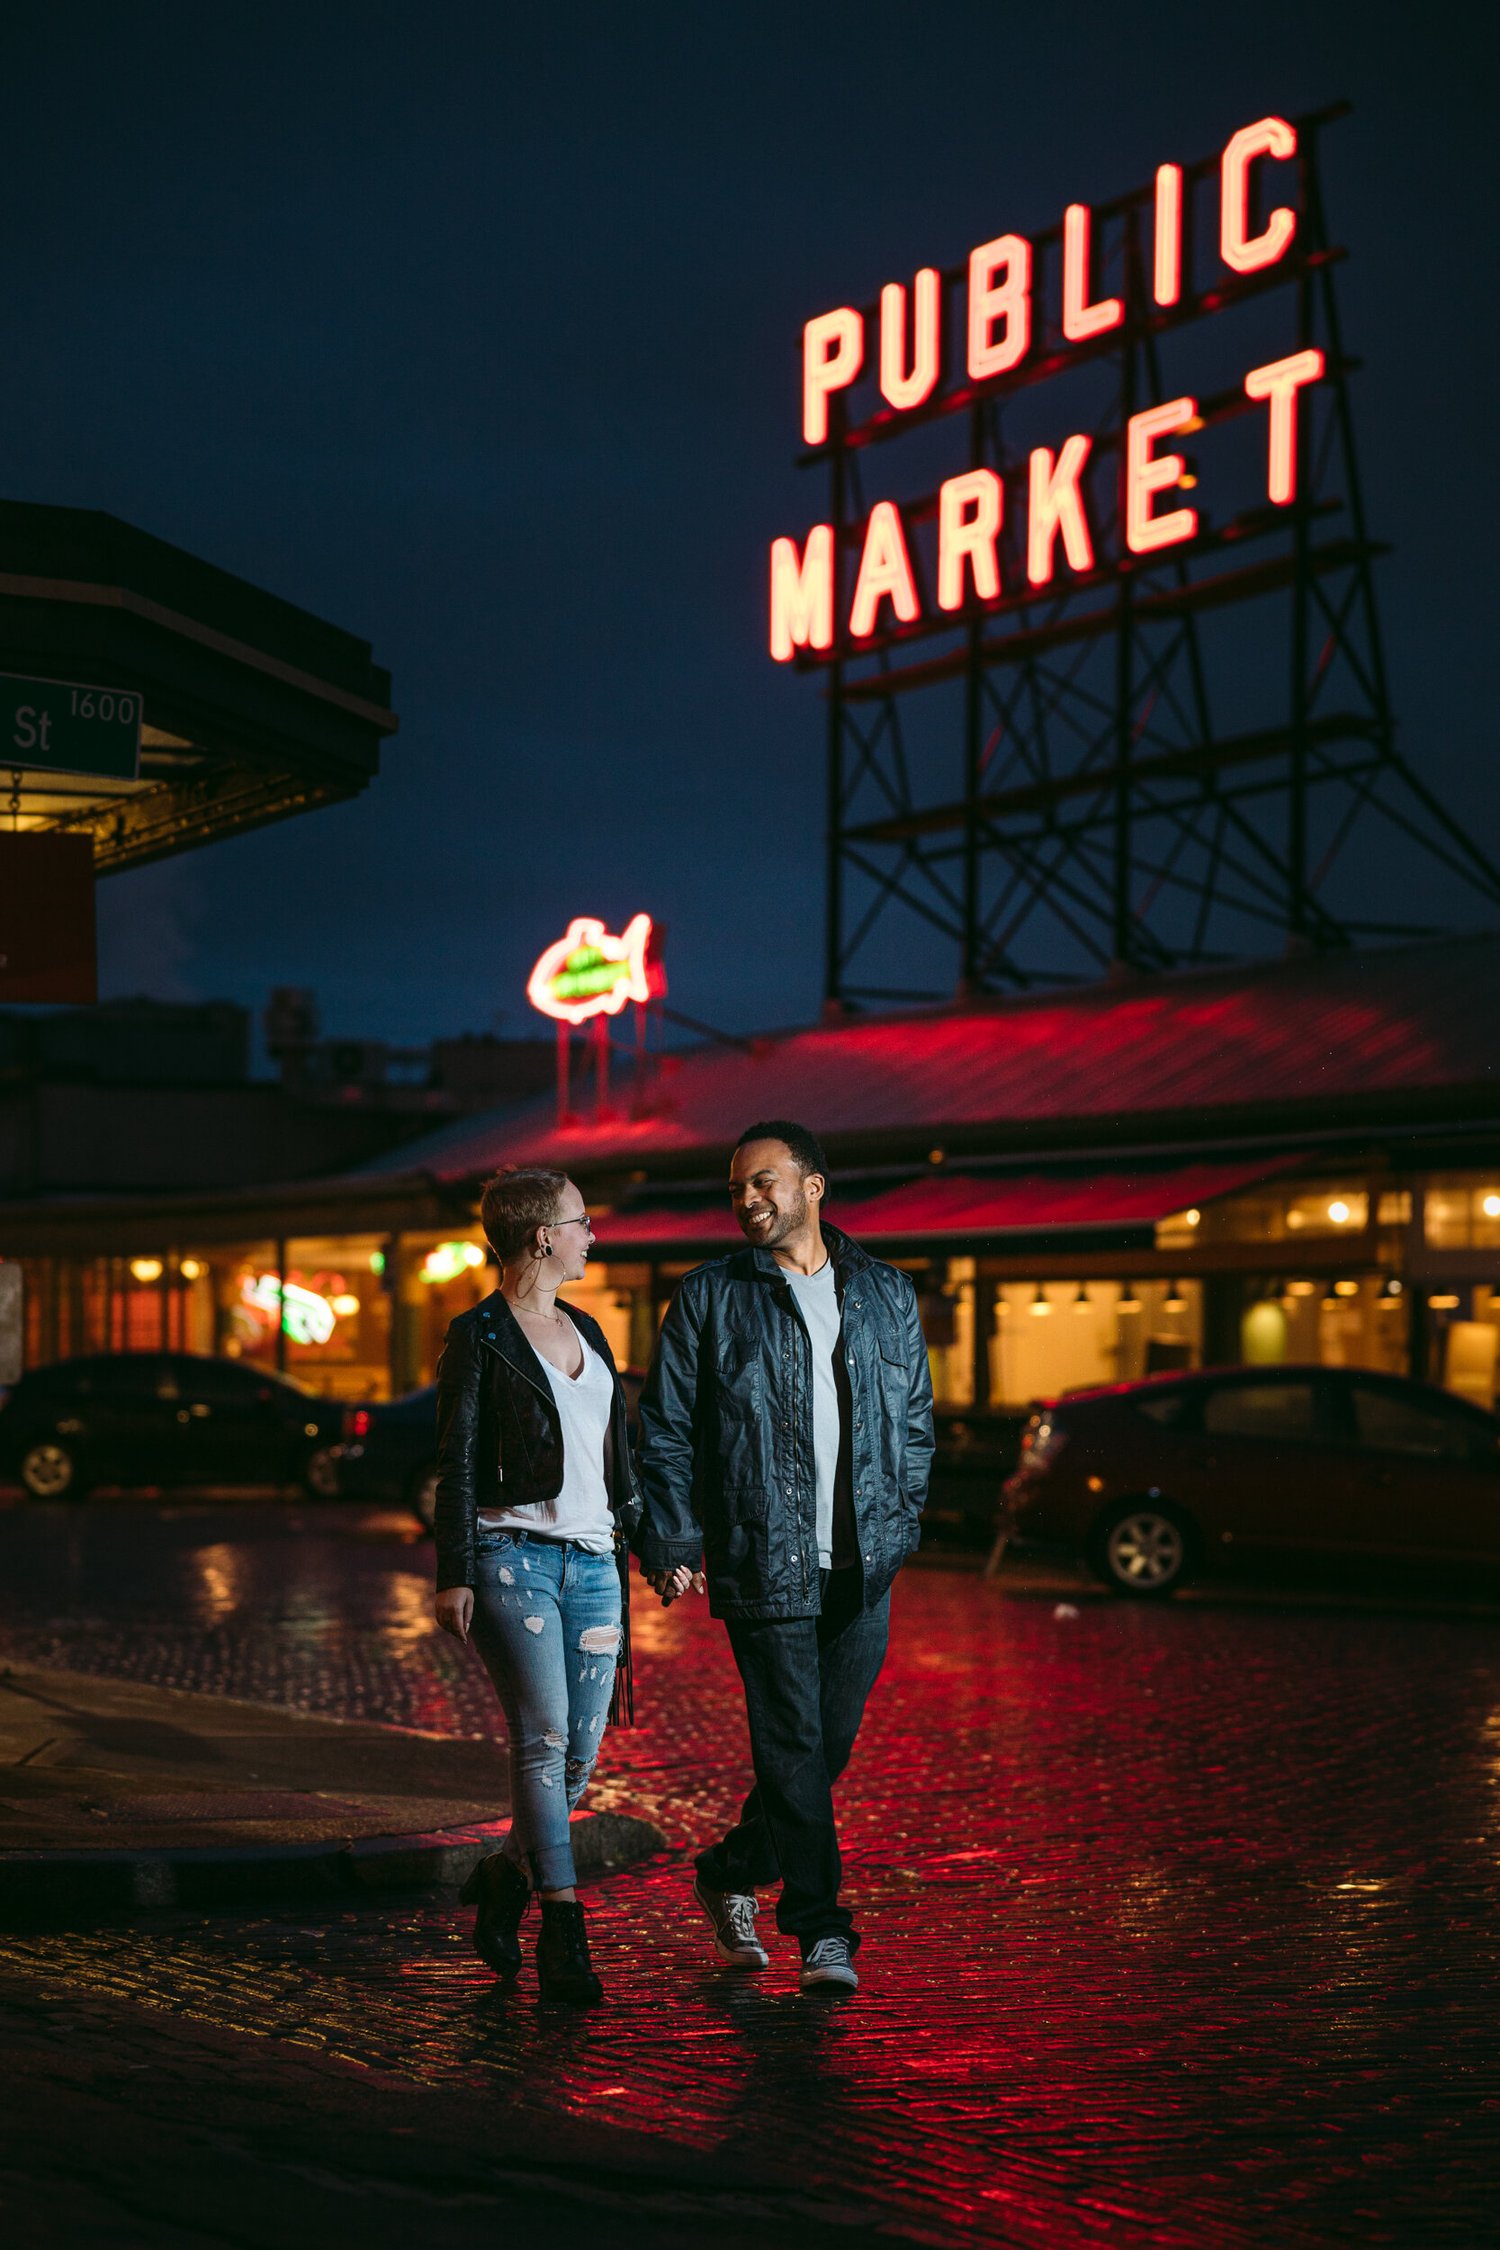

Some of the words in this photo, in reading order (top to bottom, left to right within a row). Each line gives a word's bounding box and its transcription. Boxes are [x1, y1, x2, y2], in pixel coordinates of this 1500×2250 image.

[803, 116, 1297, 446] PUBLIC
[769, 348, 1325, 662] MARKET
[12, 704, 53, 752] St
[71, 689, 135, 725] 1600
